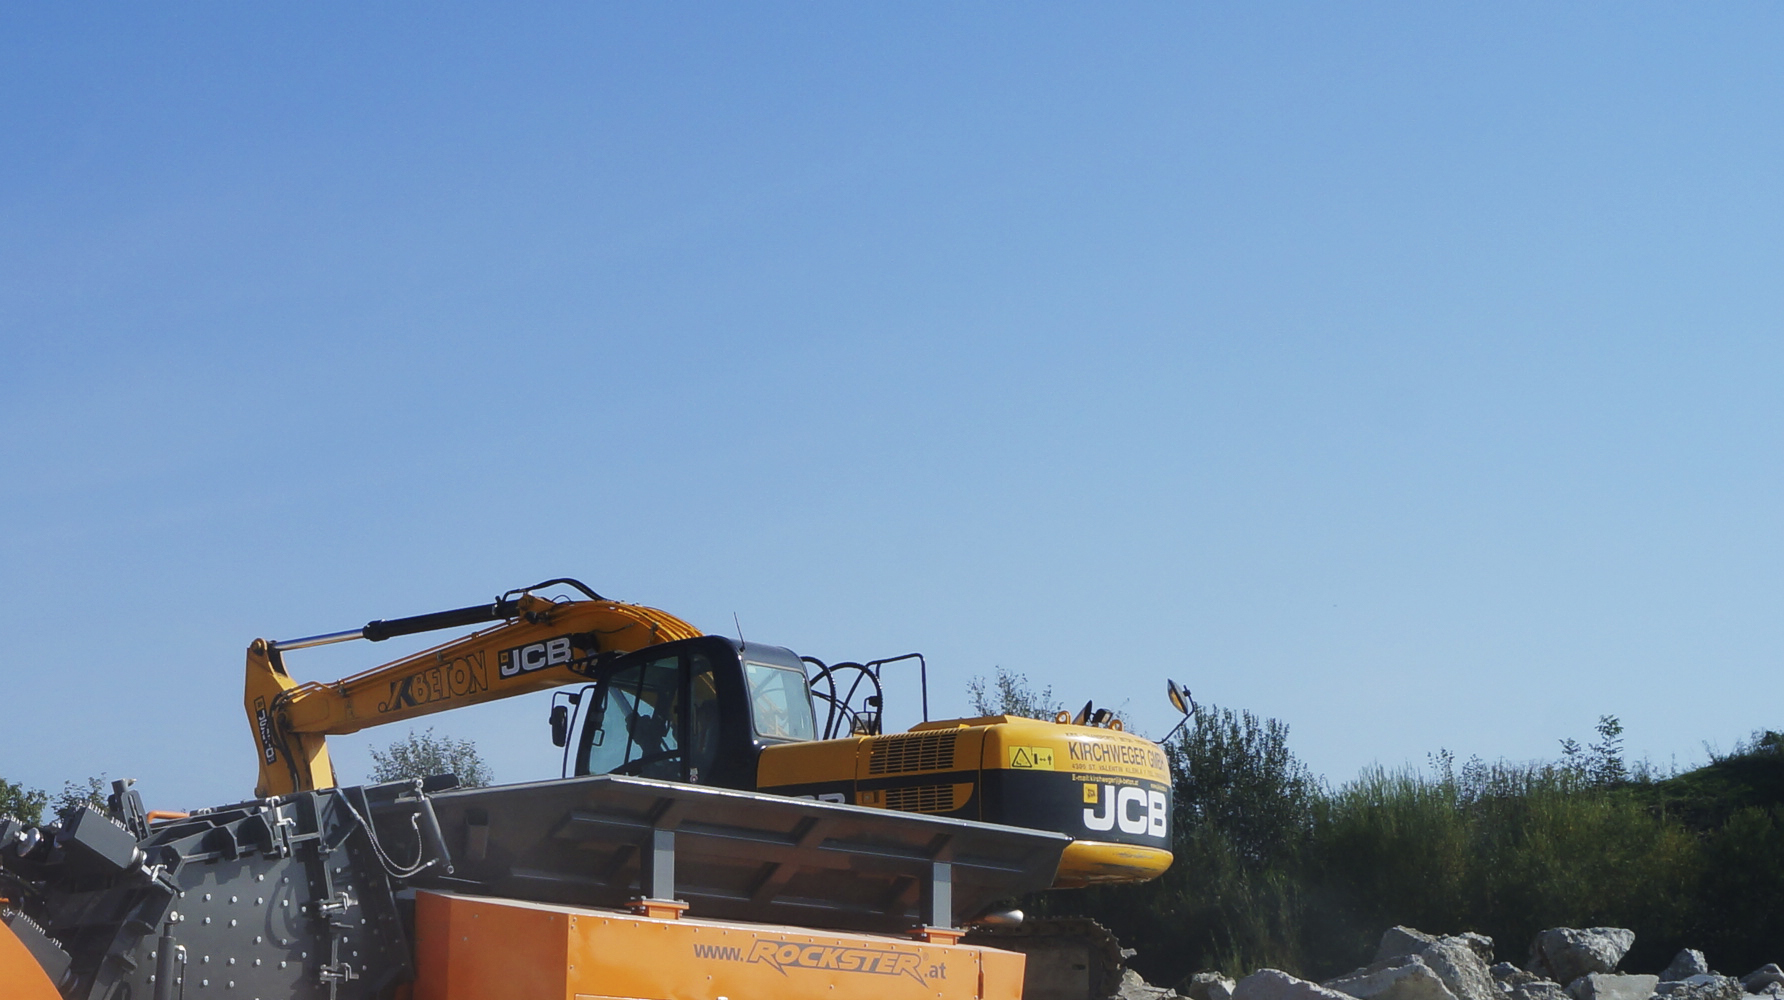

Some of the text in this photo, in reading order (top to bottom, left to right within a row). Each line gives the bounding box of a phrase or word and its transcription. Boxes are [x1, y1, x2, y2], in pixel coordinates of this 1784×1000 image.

[501, 637, 572, 677] JCB
[1068, 741, 1146, 766] KIRCHWEGER
[1083, 784, 1166, 838] JCB
